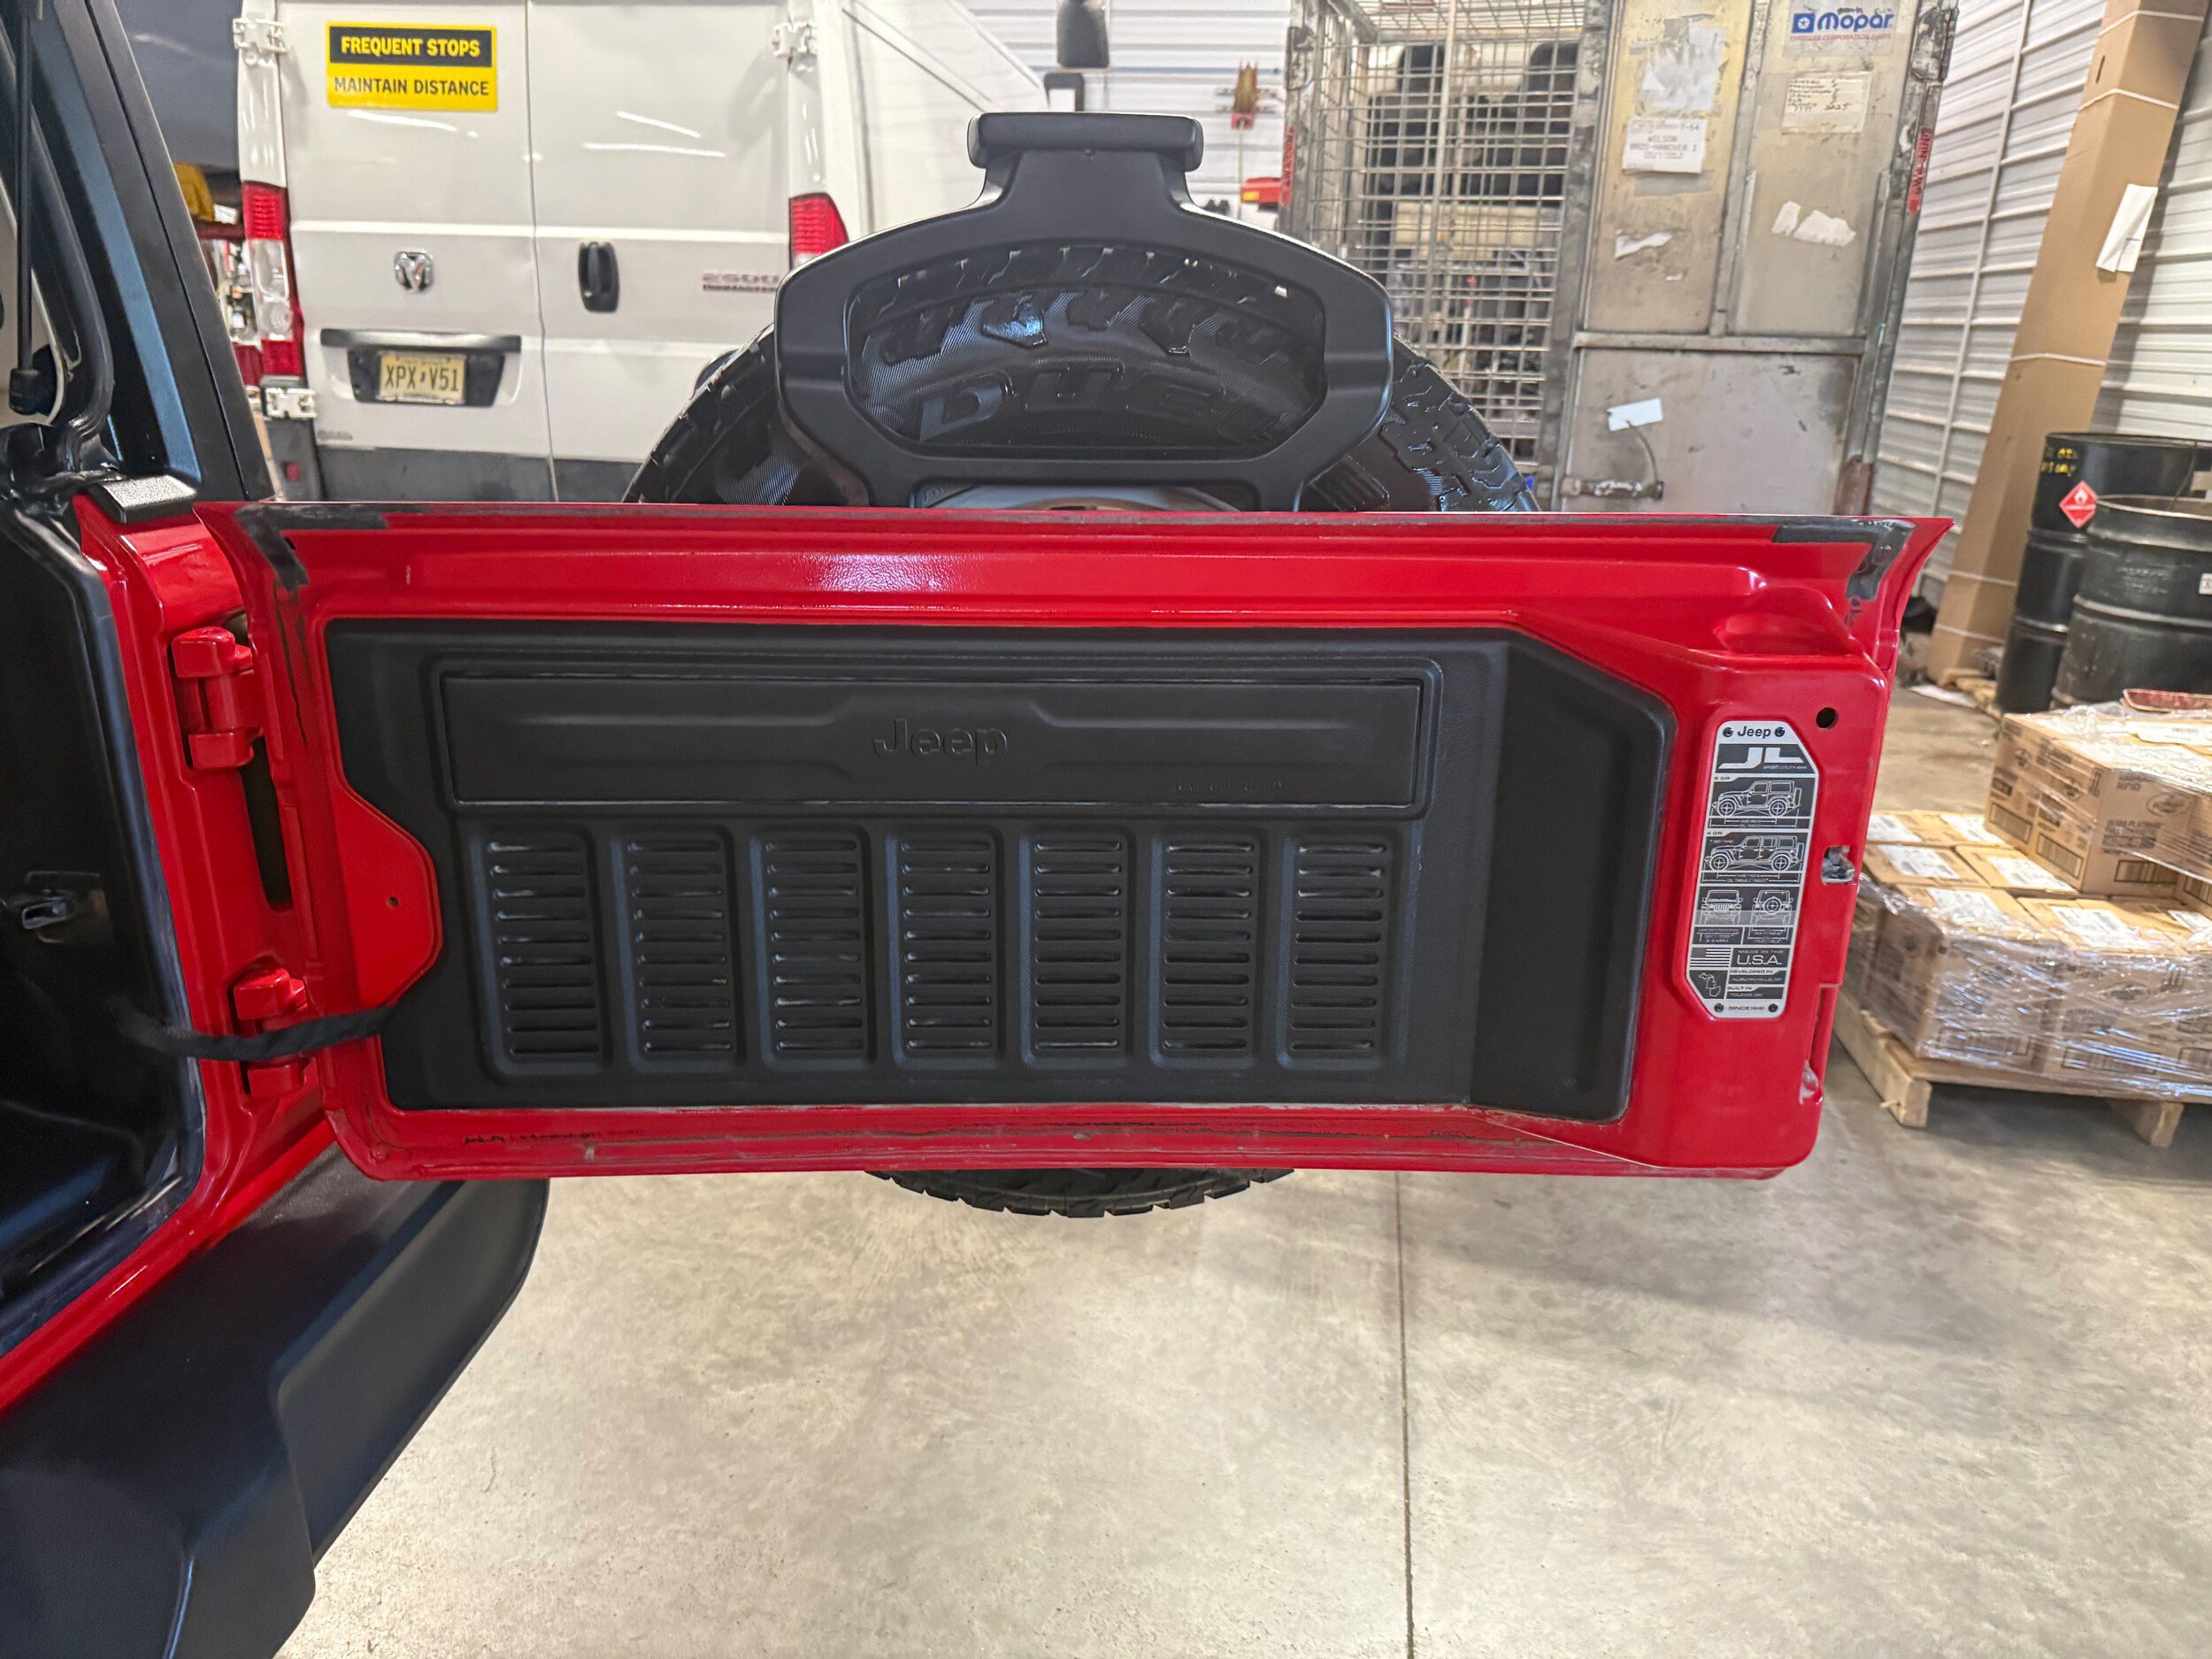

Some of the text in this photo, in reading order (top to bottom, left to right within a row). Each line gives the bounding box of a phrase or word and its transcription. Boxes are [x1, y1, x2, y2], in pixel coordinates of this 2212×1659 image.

[1817, 12, 1894, 32] Mopar
[341, 36, 480, 58] FREQUENT STOPS
[334, 76, 489, 96] MAINTAIN DISTANCE
[873, 718, 1007, 766] Jeep
[1737, 726, 1771, 739] Jeep
[1718, 748, 1804, 769] JL
[1737, 955, 1782, 965] U.S.A.
